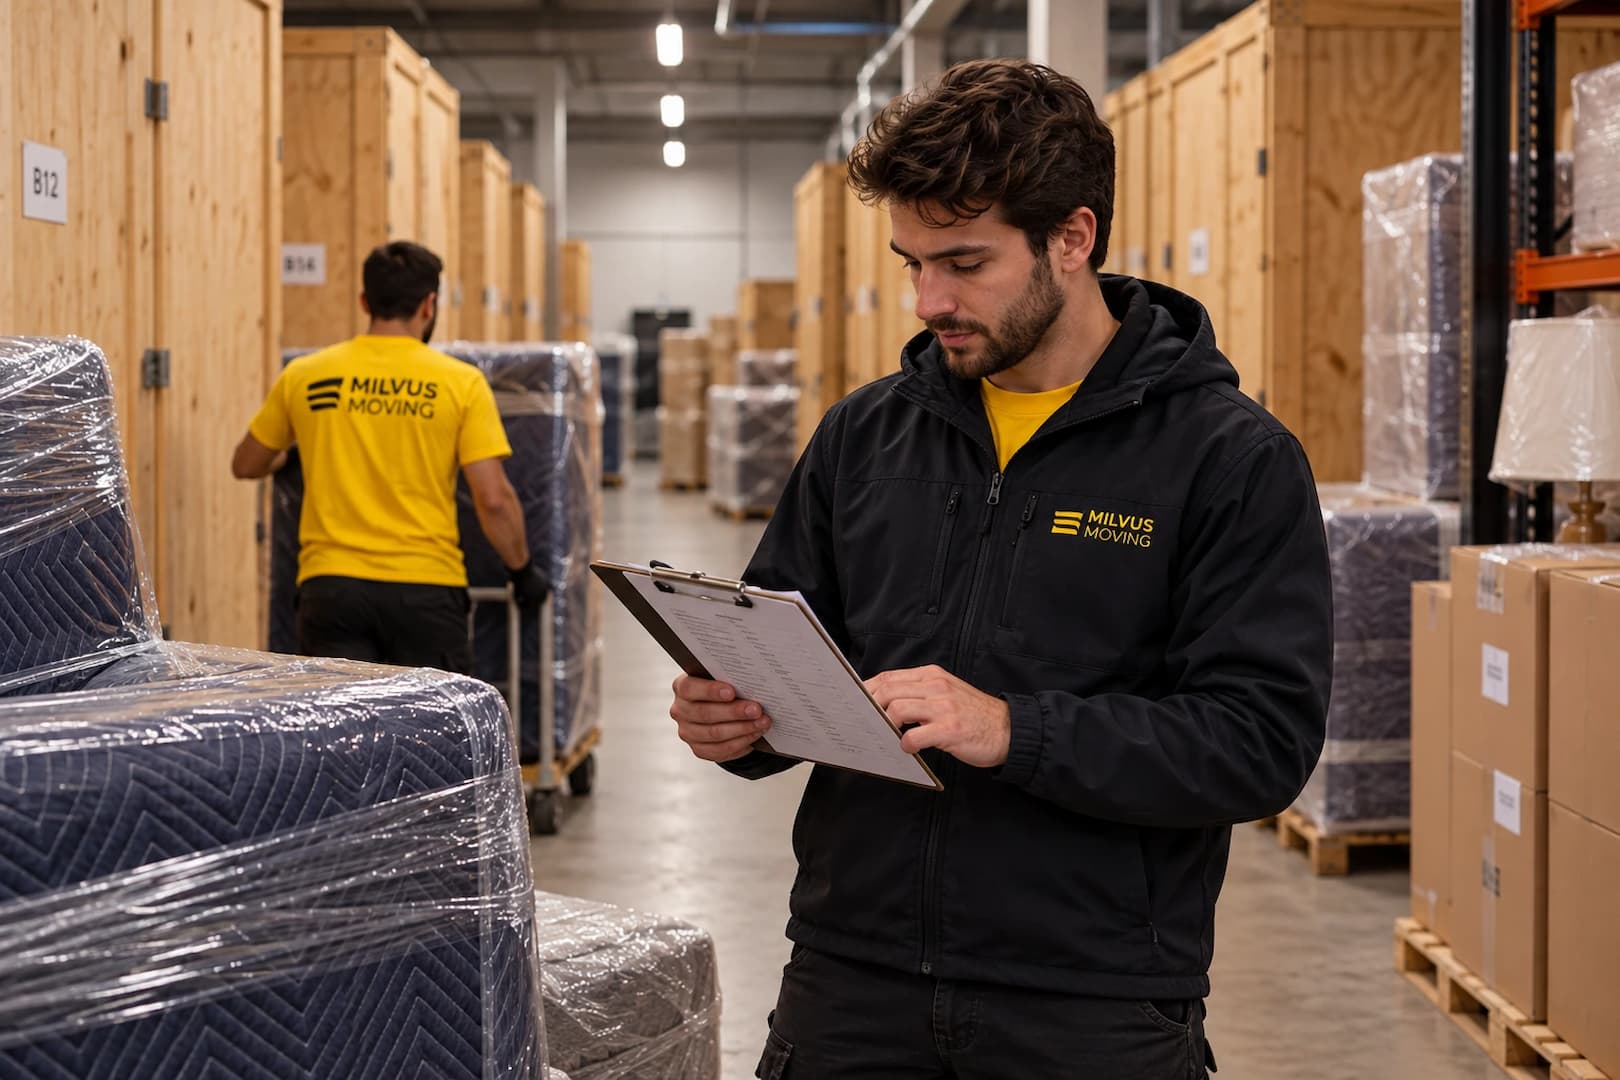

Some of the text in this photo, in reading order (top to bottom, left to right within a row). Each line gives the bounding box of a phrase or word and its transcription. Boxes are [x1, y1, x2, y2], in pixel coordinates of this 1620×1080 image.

[33, 166, 58, 198] B12
[350, 376, 438, 399] MILVUS
[348, 398, 435, 419] MOVING
[1087, 510, 1154, 532] MILVUS
[1084, 526, 1151, 547] MOVING
